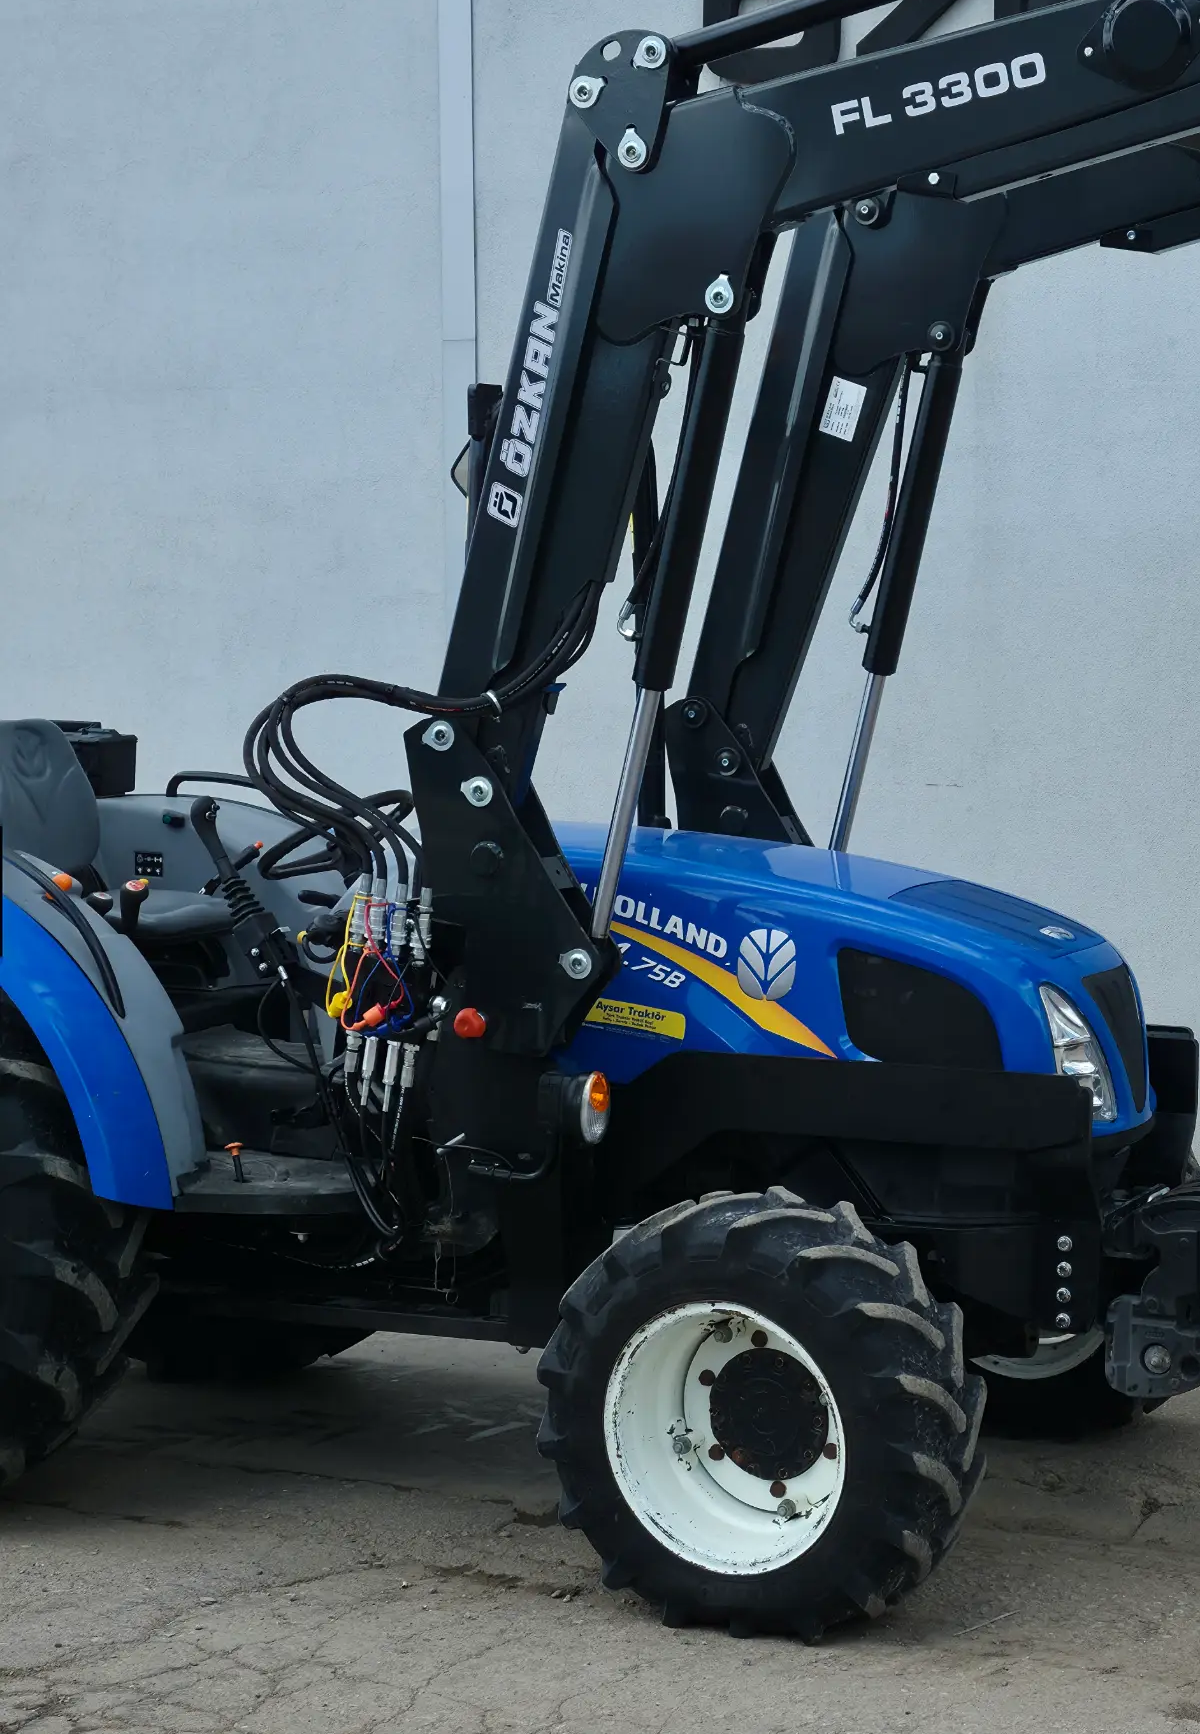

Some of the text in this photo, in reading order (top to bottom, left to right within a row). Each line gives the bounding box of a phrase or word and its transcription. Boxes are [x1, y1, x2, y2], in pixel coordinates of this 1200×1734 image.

[830, 52, 1046, 136] FL 3300
[500, 300, 560, 478] ÖZKAN
[549, 233, 571, 304] Makina
[592, 886, 728, 959] OLLAND
[595, 1000, 626, 1013] Aysar
[628, 1006, 667, 1022] Traktör
